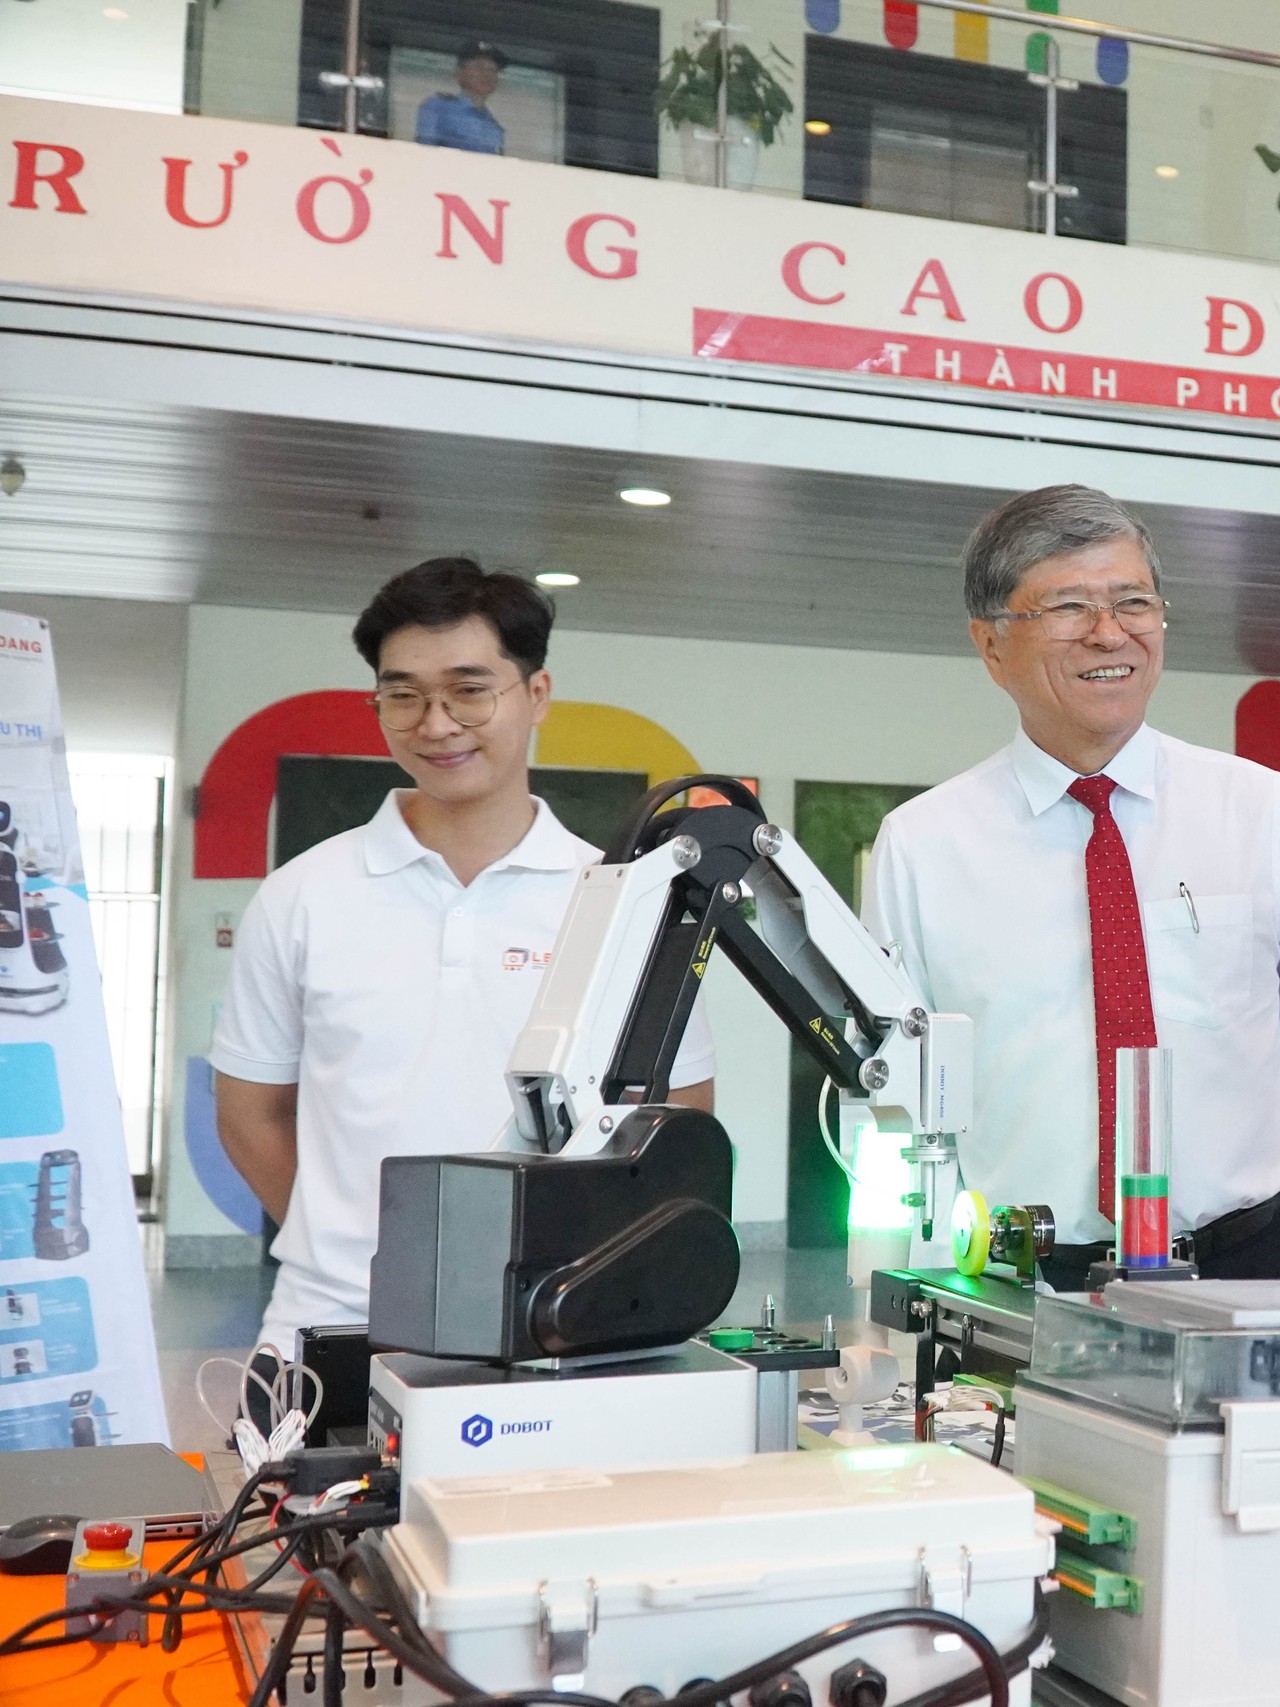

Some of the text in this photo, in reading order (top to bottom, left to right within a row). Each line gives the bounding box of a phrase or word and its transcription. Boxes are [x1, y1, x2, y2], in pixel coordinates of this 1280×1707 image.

[782, 242, 1083, 334] CAO
[884, 342, 1117, 399] THÀNH
[500, 1420, 553, 1435] DOBOT
